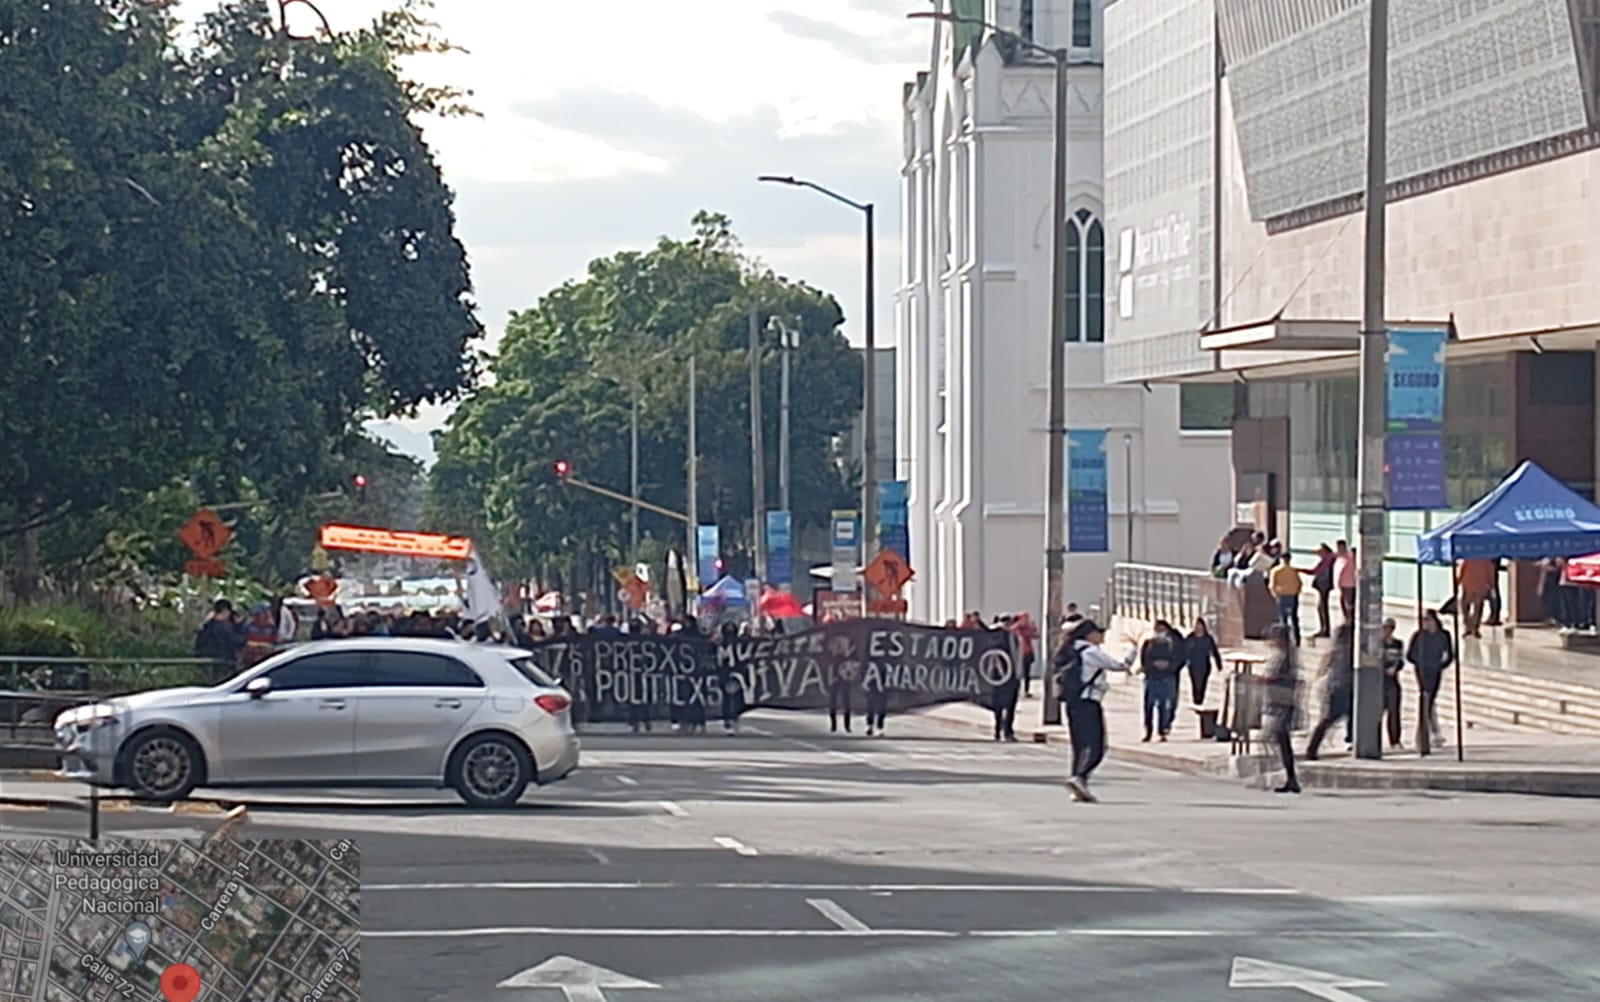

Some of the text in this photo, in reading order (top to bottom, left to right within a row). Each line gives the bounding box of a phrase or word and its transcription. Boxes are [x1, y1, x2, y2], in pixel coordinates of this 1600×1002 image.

[594, 640, 695, 673] PRESXS
[717, 632, 826, 667] MUERTE
[870, 631, 974, 660] ESTADO
